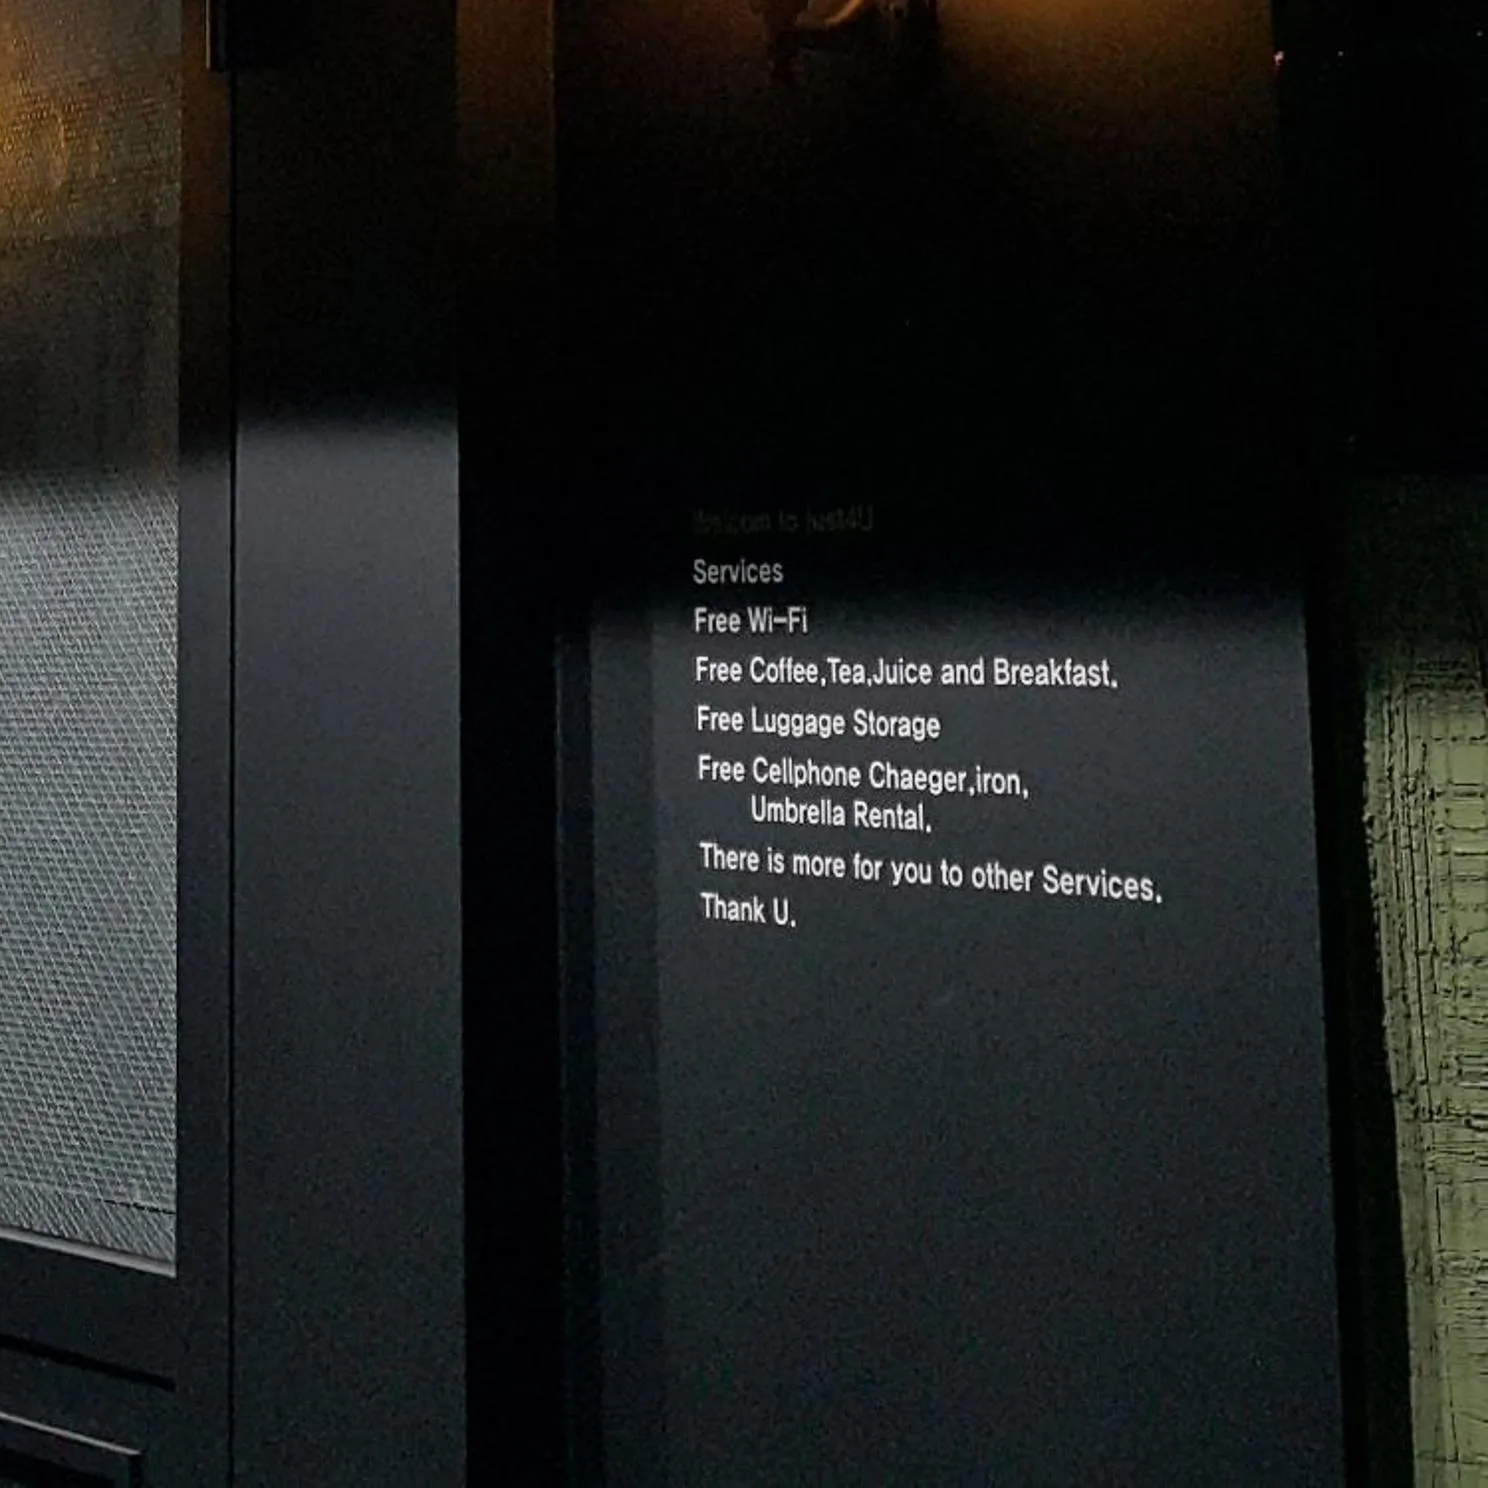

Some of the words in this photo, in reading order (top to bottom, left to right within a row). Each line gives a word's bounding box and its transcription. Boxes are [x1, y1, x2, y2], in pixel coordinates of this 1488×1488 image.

[693, 558, 784, 585] Services
[694, 607, 741, 633] Free
[748, 606, 809, 634] Wi-Fi
[695, 656, 742, 682] Free
[941, 657, 985, 686] and
[994, 657, 1118, 689] Breakfast.
[697, 706, 744, 731] Free
[751, 706, 845, 738] Luggage
[853, 708, 941, 742] Storage
[698, 753, 745, 781] Free
[752, 756, 861, 788] Cellphone
[751, 794, 846, 826] Umbrella
[853, 799, 932, 833] Rental.
[699, 841, 760, 873] There
[767, 846, 785, 874] is
[792, 855, 845, 879] more
[853, 852, 882, 881] for
[890, 861, 933, 887] you
[940, 859, 963, 888] to
[971, 861, 1034, 893] other
[1043, 864, 1163, 904] Services.
[700, 892, 766, 924] Thank
[772, 898, 797, 927] U.
